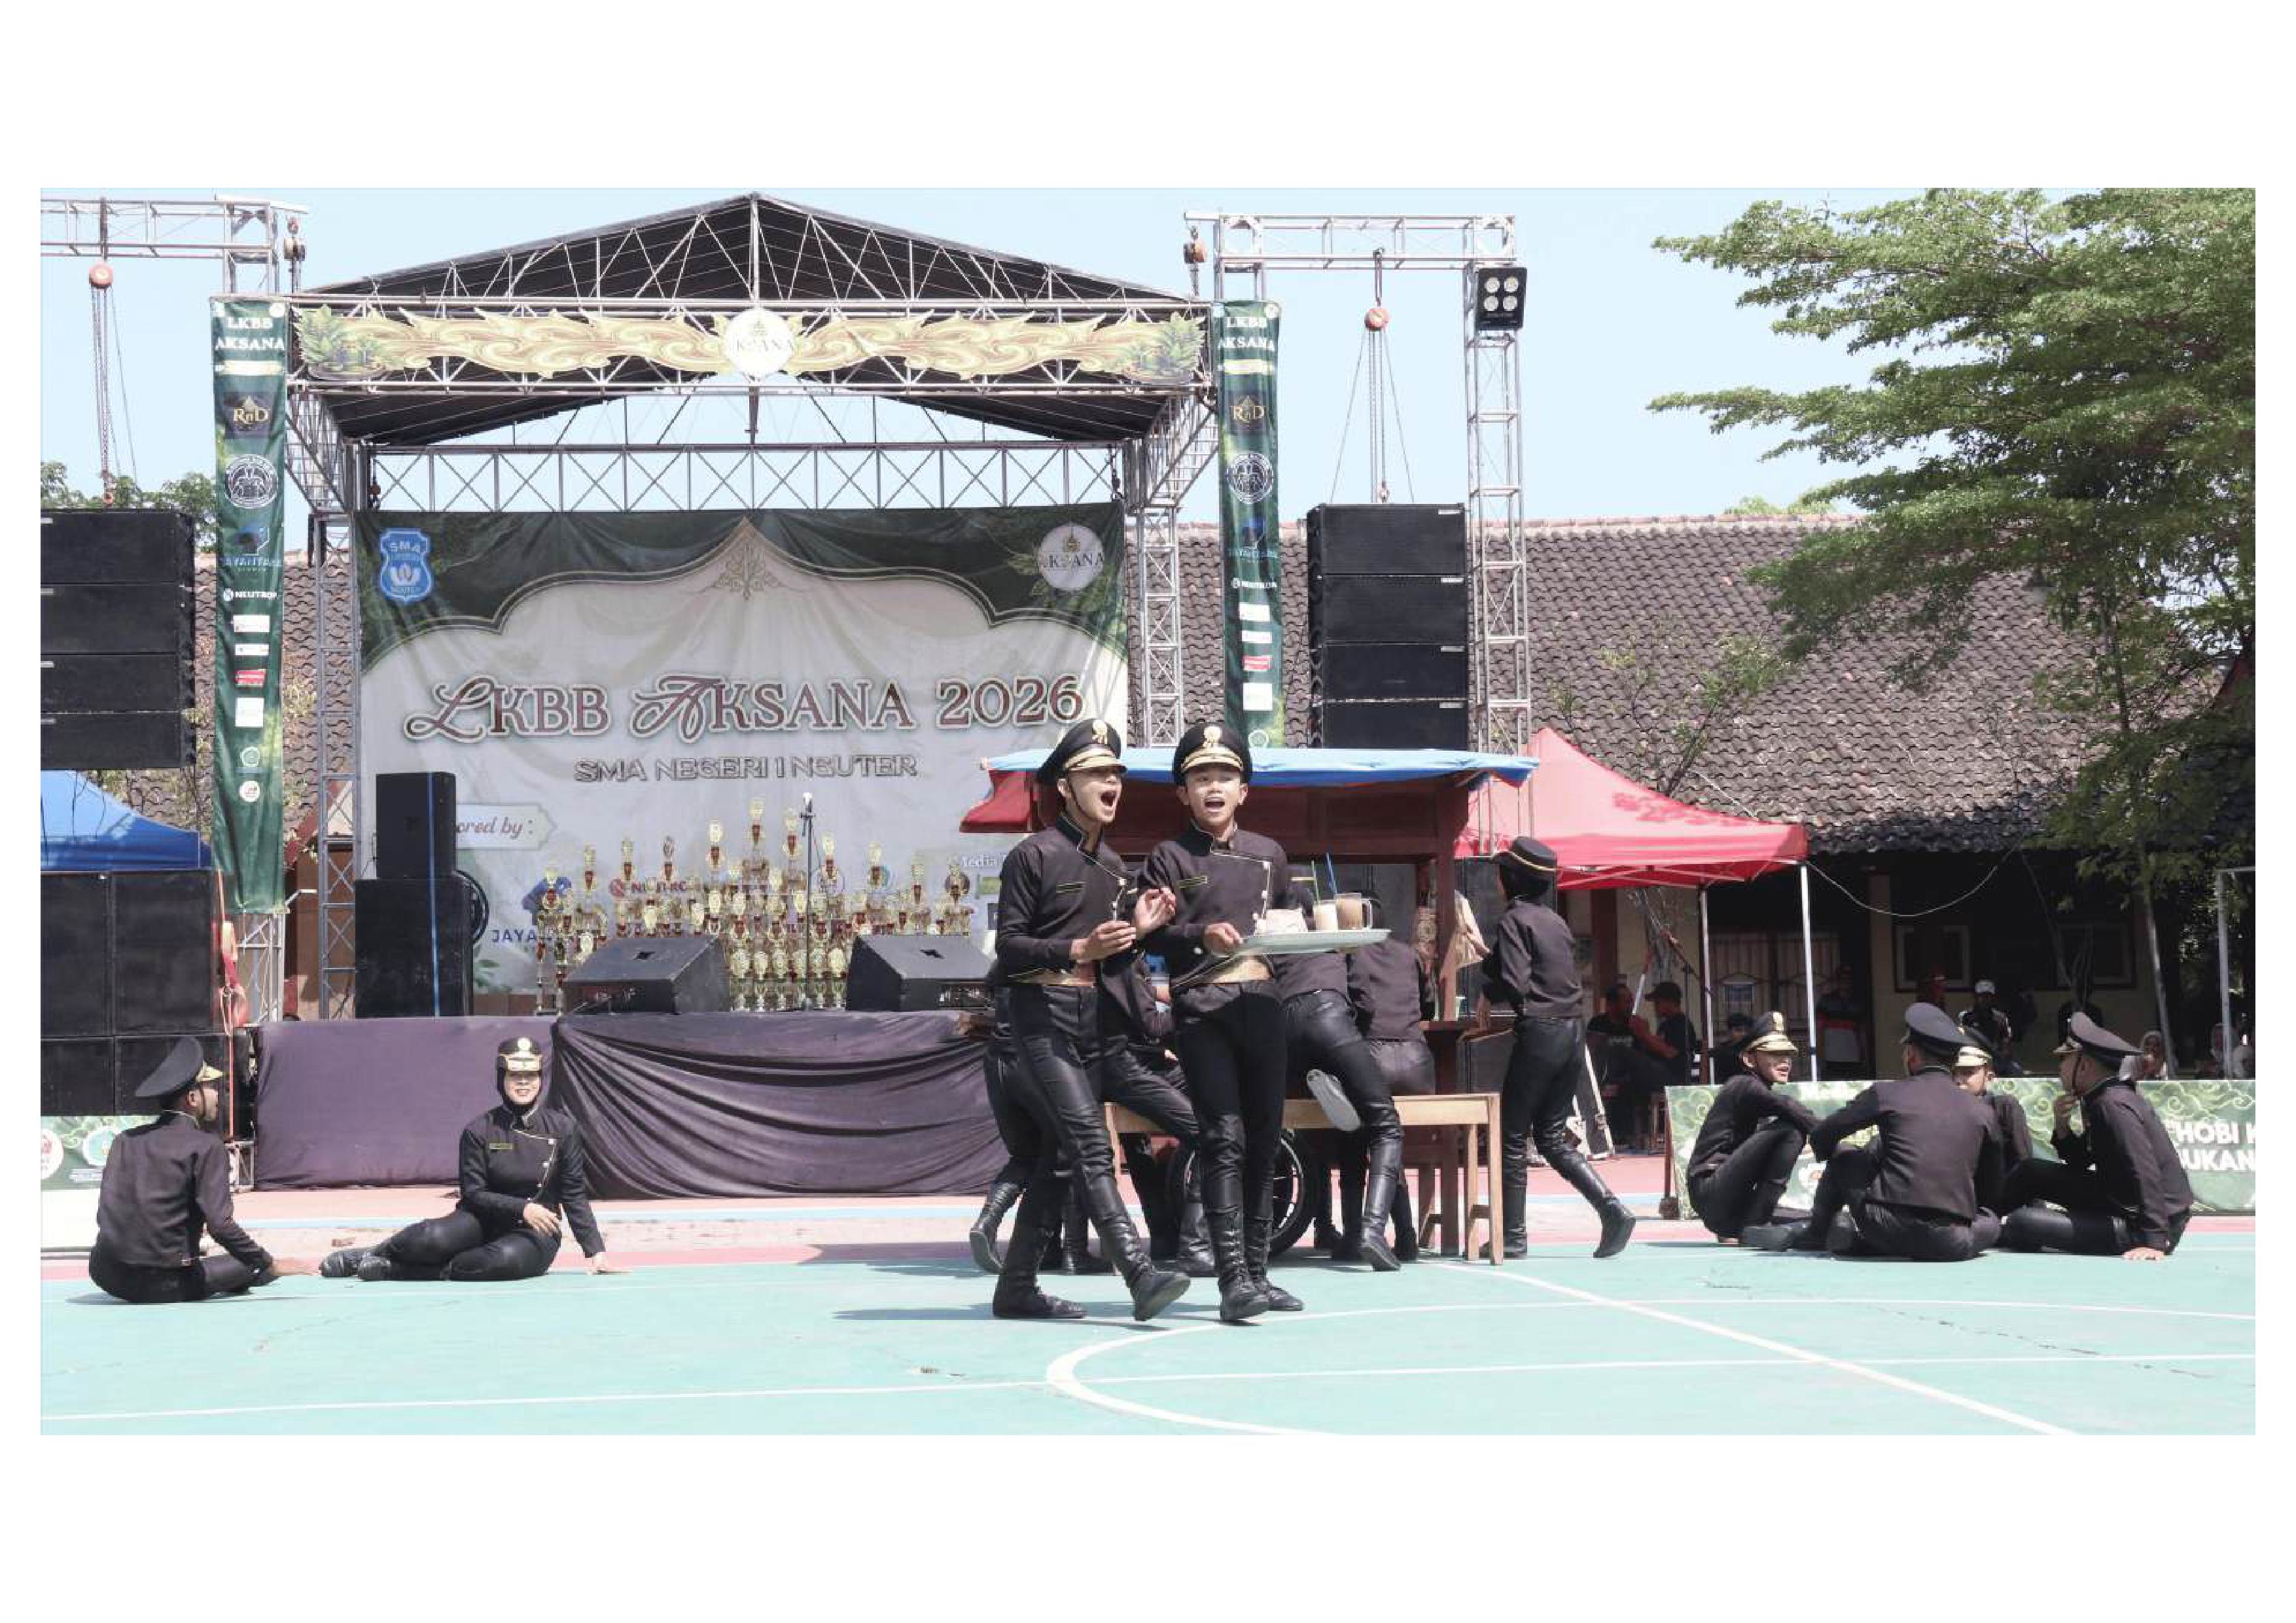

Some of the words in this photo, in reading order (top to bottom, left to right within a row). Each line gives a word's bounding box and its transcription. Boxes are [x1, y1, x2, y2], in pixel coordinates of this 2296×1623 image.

[215, 336, 285, 350] AKSANA
[234, 408, 270, 424] RnD
[391, 541, 421, 552] SMA
[404, 671, 612, 743] LKBB
[631, 673, 917, 744] AKSANA
[936, 673, 1084, 728] 2026
[573, 757, 648, 782] SMA
[655, 756, 768, 781] NEGERI
[791, 755, 918, 778] NGUTER
[500, 816, 523, 840] by
